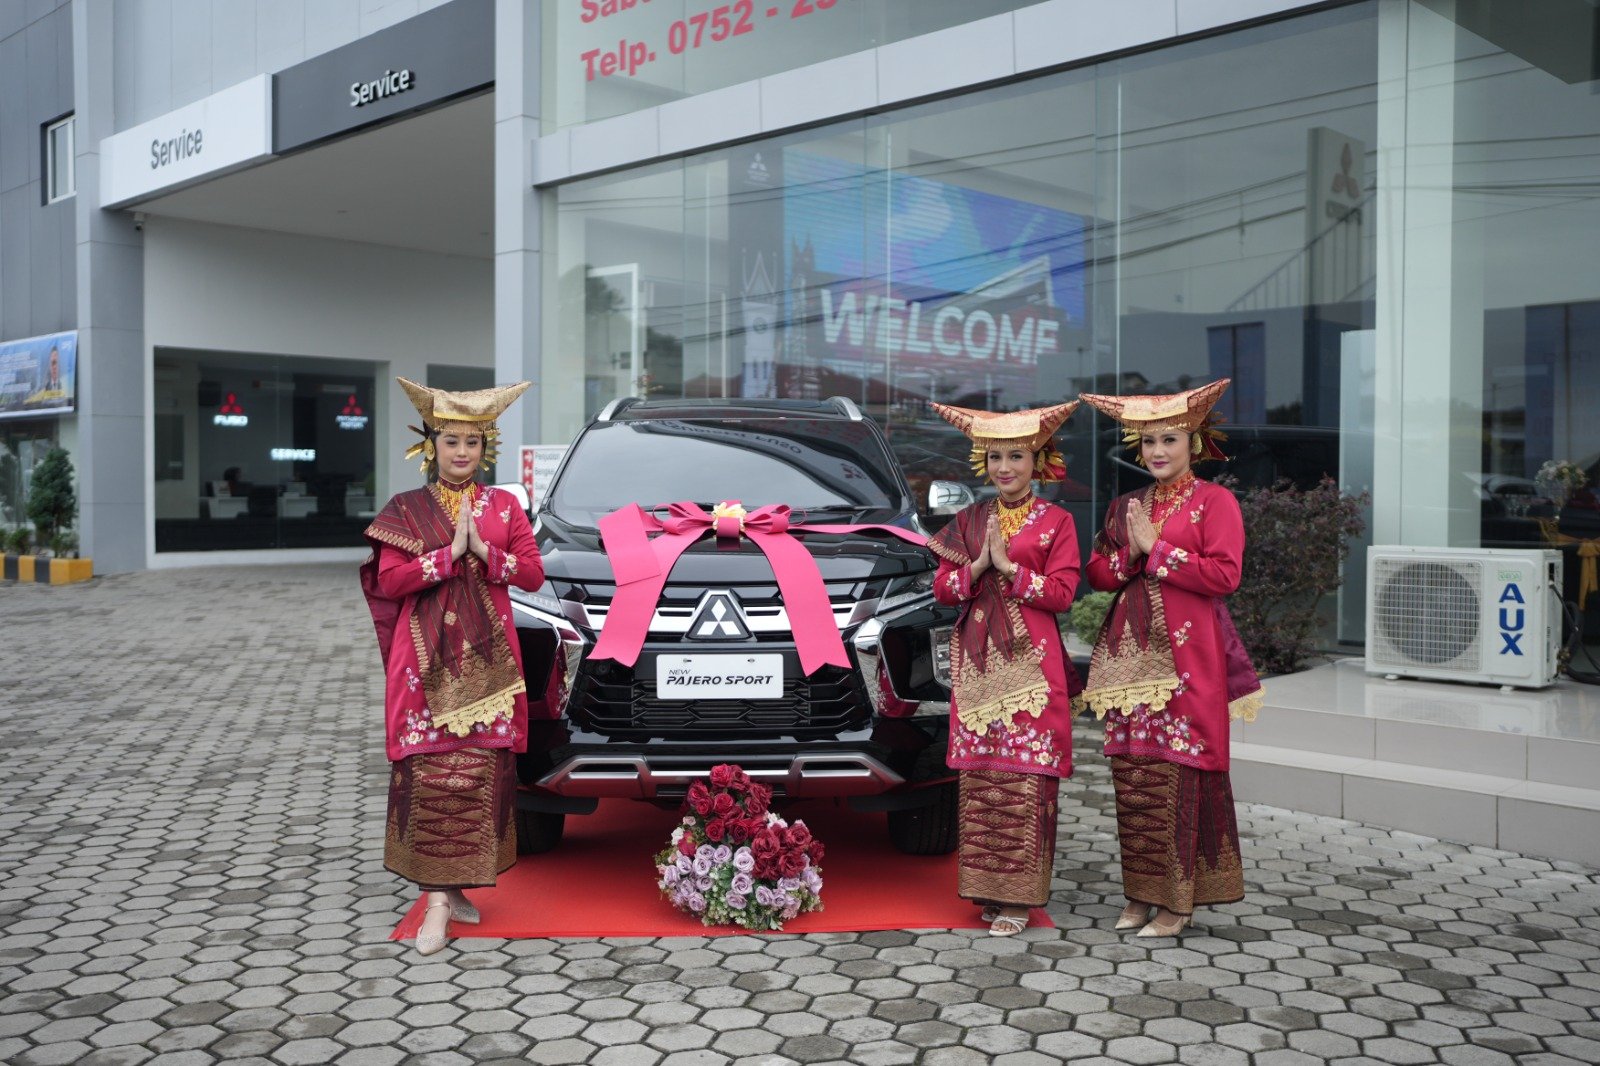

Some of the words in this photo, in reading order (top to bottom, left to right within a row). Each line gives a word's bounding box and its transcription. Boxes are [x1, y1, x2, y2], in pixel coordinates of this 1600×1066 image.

[580, 39, 657, 82] Telp.
[668, 0, 755, 55] 0752
[350, 69, 410, 107] Service
[150, 128, 204, 170] Service
[820, 289, 1059, 365] WELCOME
[270, 448, 316, 461] SERVICE
[1498, 582, 1526, 656] AUX
[666, 675, 722, 686] PAJERO
[724, 675, 774, 685] SPORT
